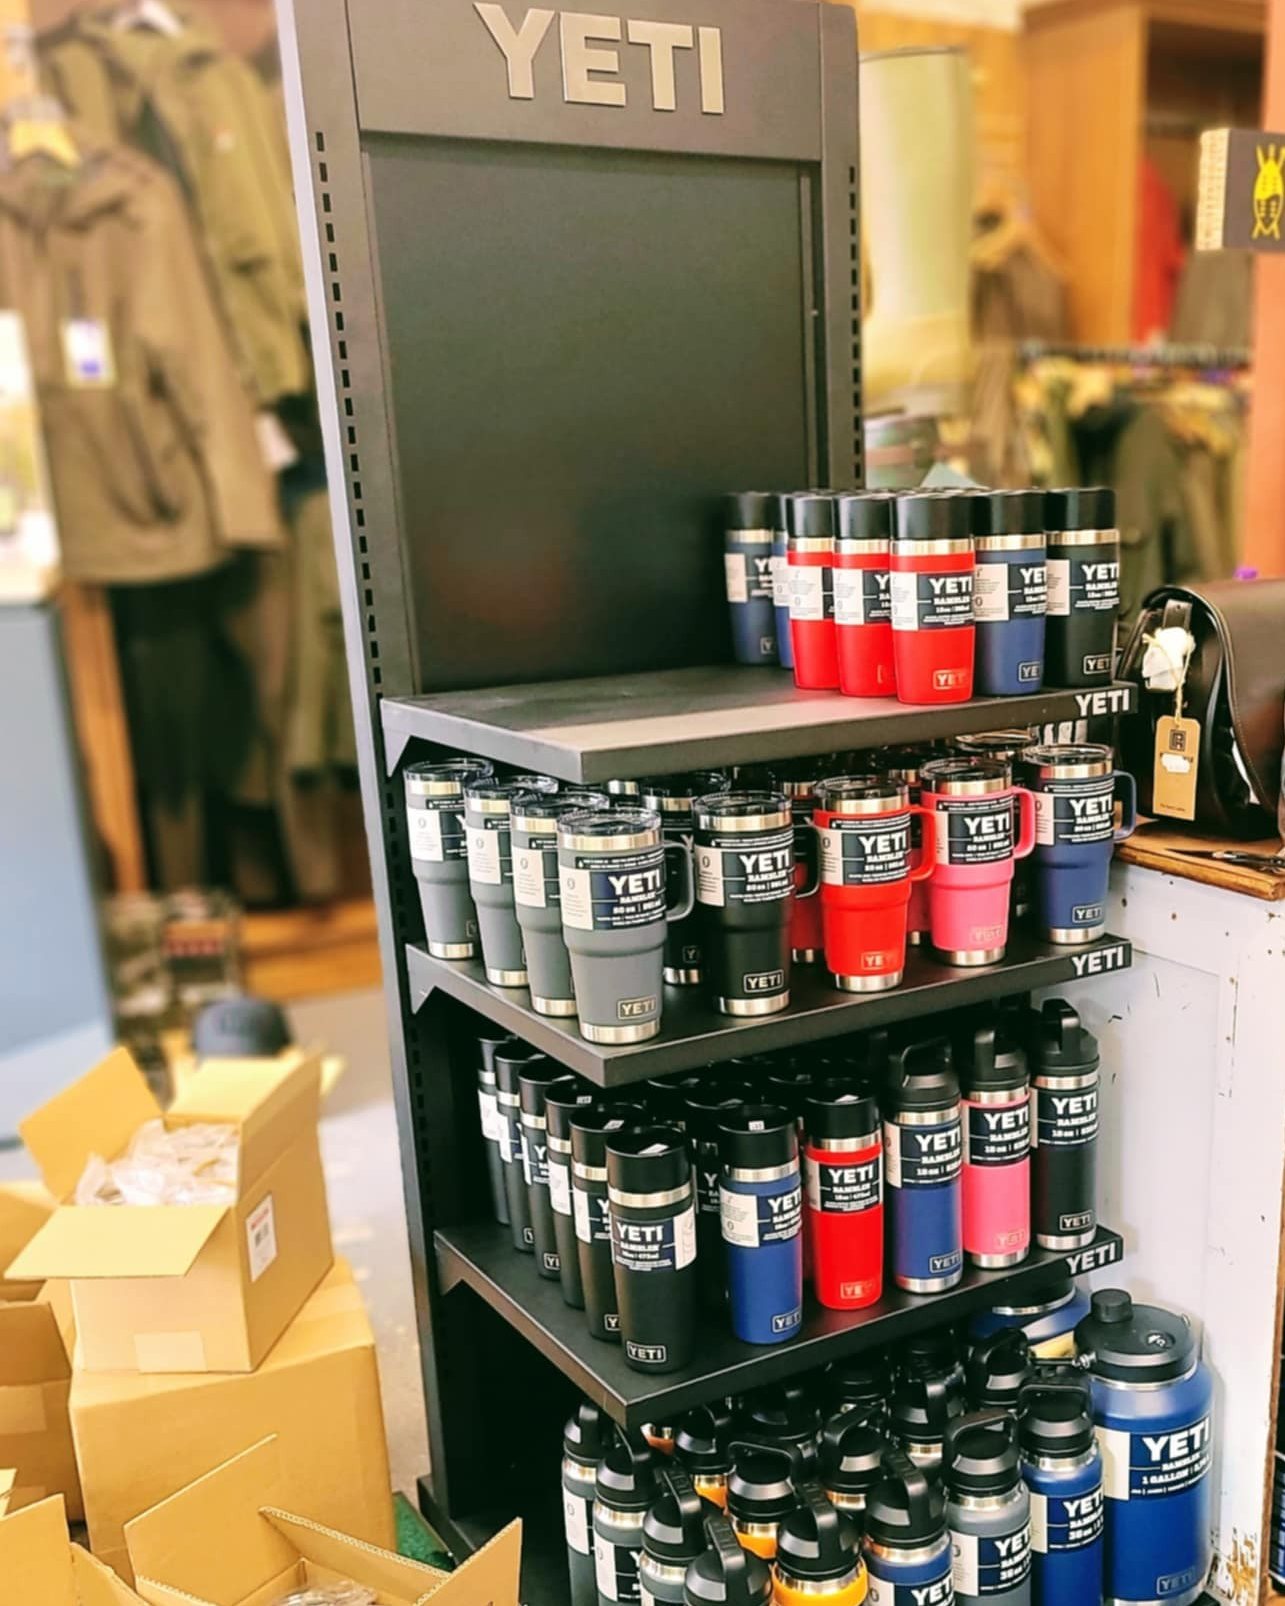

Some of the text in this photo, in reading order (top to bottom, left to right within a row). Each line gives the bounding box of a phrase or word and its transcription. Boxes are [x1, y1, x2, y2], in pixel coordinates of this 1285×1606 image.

[473, 2, 724, 115] YETI
[1081, 562, 1119, 581] YETI
[929, 575, 973, 595] YETI
[1075, 688, 1130, 717] YETI
[1069, 793, 1112, 817] YETI
[963, 812, 1010, 835] YETI
[858, 830, 907, 854] YETI
[739, 848, 790, 874] YETI
[607, 868, 660, 896] YETI
[1071, 946, 1124, 976] YETI
[748, 973, 781, 989] YETI
[622, 997, 656, 1015] YETI
[1051, 1091, 1097, 1115] YETI
[983, 1104, 1028, 1130] YETI
[915, 1126, 960, 1153] YETI
[828, 1163, 873, 1184] YETI
[616, 1221, 664, 1242] YETI
[1063, 1215, 1091, 1229] YETI
[1066, 1242, 1117, 1275] YETI
[631, 1344, 662, 1359] YETI
[1142, 1416, 1210, 1462] YETI
